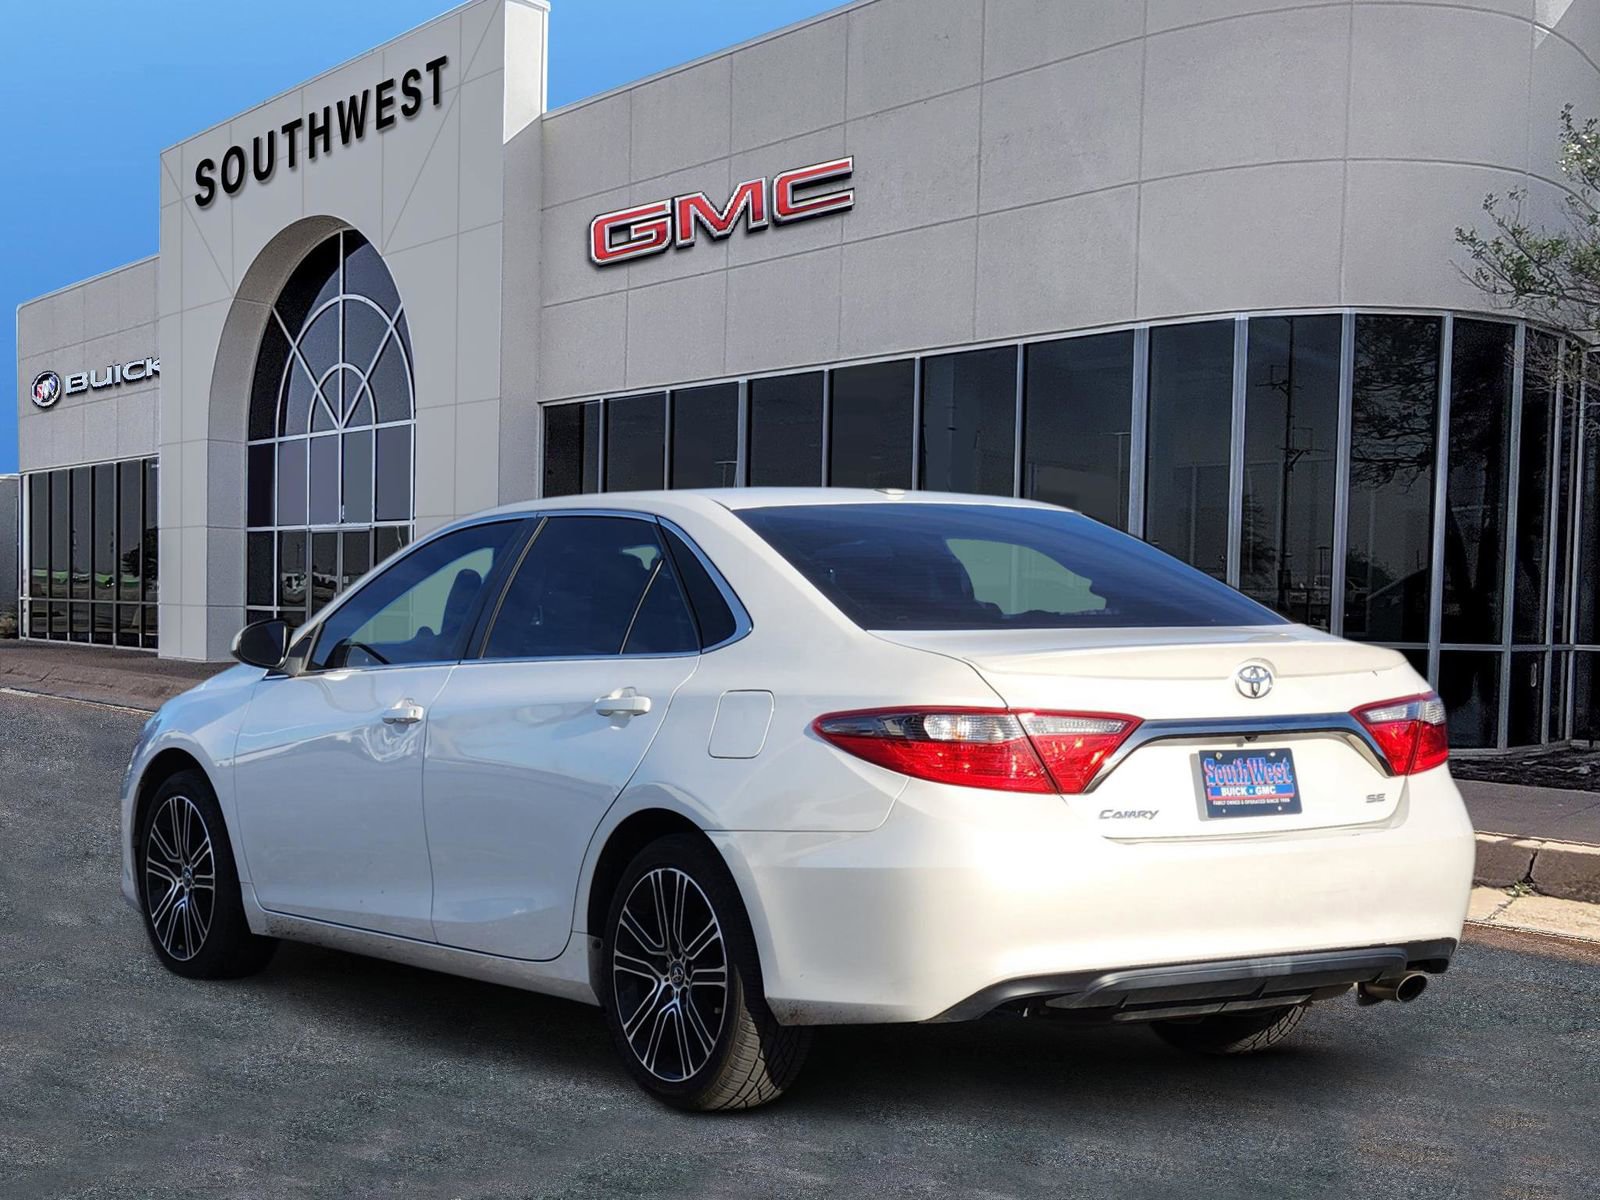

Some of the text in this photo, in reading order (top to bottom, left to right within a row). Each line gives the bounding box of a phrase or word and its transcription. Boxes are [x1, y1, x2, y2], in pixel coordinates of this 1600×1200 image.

[194, 55, 447, 207] SOUTHWEST
[589, 155, 854, 266] GMC
[64, 357, 160, 394] BUICK
[1221, 785, 1277, 797] BUICK GMC
[1365, 793, 1386, 803] SE
